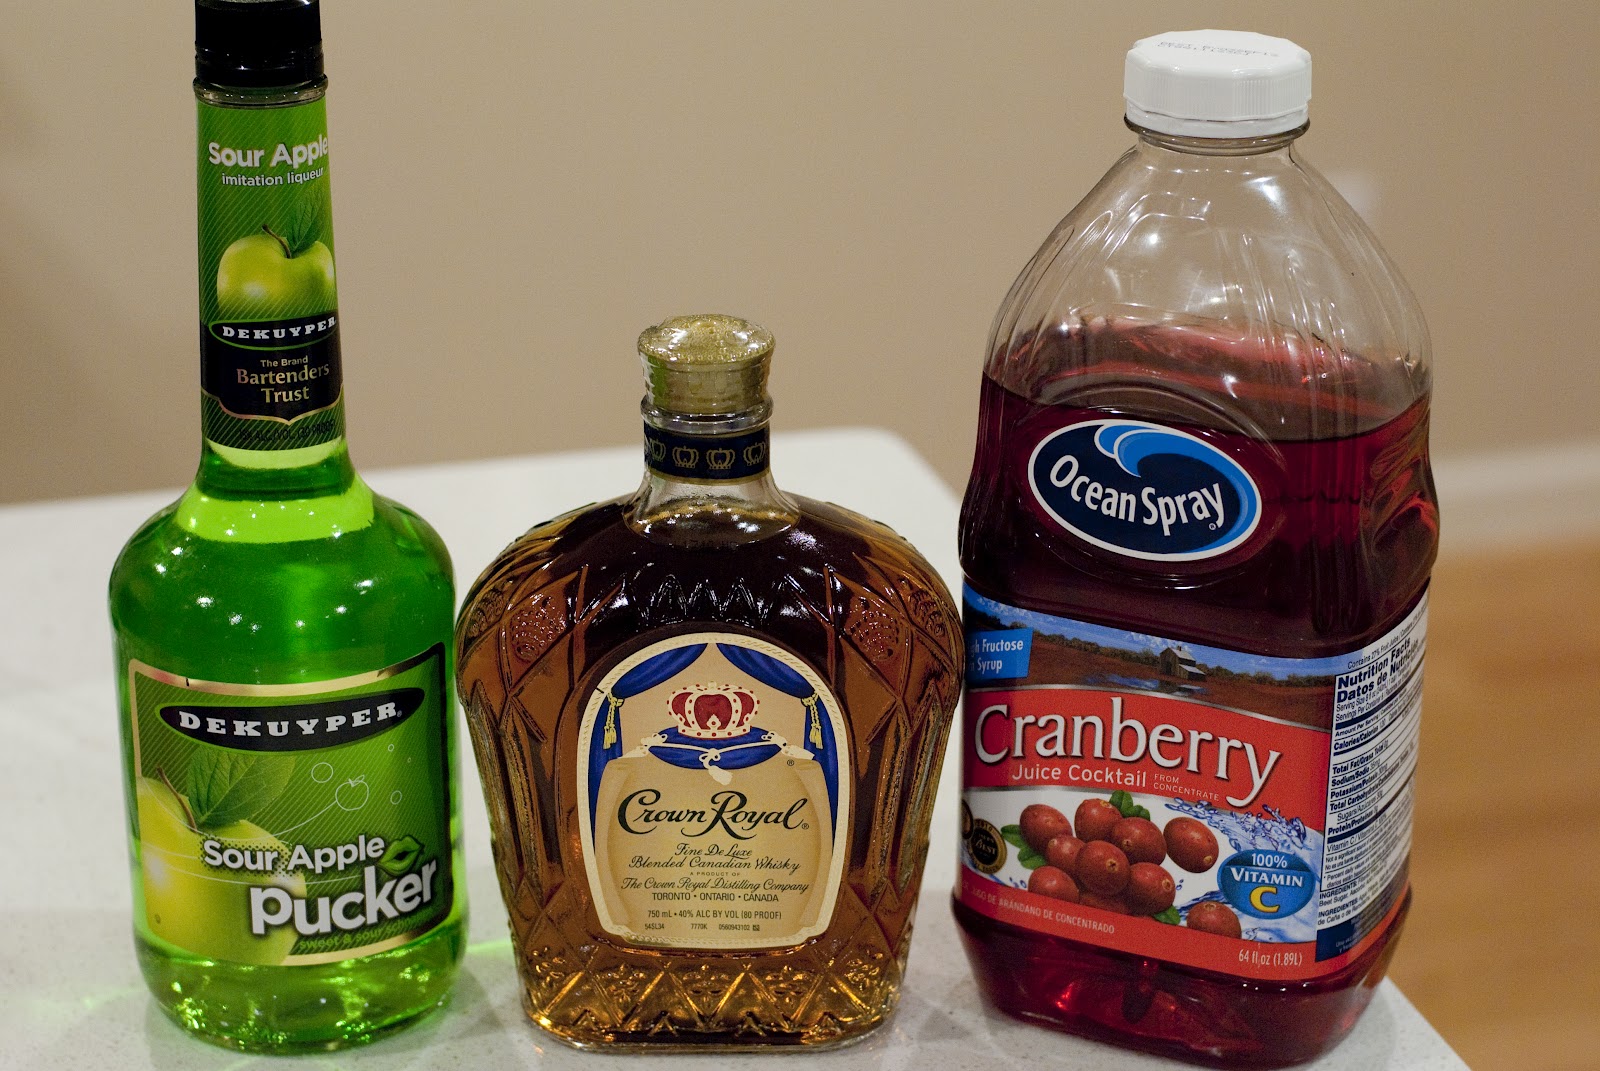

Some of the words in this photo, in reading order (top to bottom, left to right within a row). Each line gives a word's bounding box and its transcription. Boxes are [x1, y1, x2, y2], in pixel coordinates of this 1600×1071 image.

[208, 141, 265, 167] Sour
[269, 133, 328, 169] Apple
[222, 172, 283, 186] imitation
[287, 167, 324, 185] liqueur
[222, 317, 337, 339] DEKUYPER
[260, 359, 279, 368] The
[281, 355, 309, 367] Brand
[236, 363, 330, 385] Bartenders
[260, 386, 310, 403] Trust
[1050, 455, 1136, 523] Ocean
[1141, 483, 1225, 537] Spray
[982, 639, 1024, 652] Fructose
[977, 656, 1003, 674] Syrup
[1337, 657, 1389, 689] Nutrition
[1391, 637, 1411, 662] Facts
[1347, 655, 1371, 669] Contains
[1336, 681, 1375, 703] Datos
[1377, 671, 1387, 685] de
[1335, 709, 1357, 722] Servings
[1357, 706, 1365, 715] Per
[1336, 698, 1355, 713] Serving
[179, 702, 397, 737] DEKUYPER
[1335, 726, 1357, 737] Amount
[1357, 722, 1365, 731] Per
[974, 697, 1281, 807] Cranberry
[1012, 763, 1062, 781] Juice
[1069, 765, 1147, 788] Cocktail
[1332, 764, 1349, 775] Total
[1154, 773, 1179, 784] FROM
[1153, 782, 1220, 801] CONCENTRATE
[1329, 800, 1347, 811] Total
[618, 789, 707, 835] Crown
[681, 790, 808, 840] Royal
[203, 840, 280, 871] Sour
[286, 835, 385, 873] Apple
[674, 843, 703, 856] Fine
[704, 843, 725, 856] De
[724, 843, 753, 860] Luxe
[1326, 839, 1349, 853] Vitamin
[628, 856, 685, 869] Blended
[689, 857, 751, 869] Canadian
[754, 856, 801, 876] Whisky
[1251, 853, 1288, 869] 100%
[621, 878, 642, 889] The
[643, 878, 676, 890] Crown
[677, 877, 710, 892] Royal
[711, 878, 761, 892] Distilling
[763, 879, 809, 892] Company
[1230, 867, 1303, 887] VITAMIN
[249, 860, 437, 936] pucker
[652, 893, 691, 901] TORONTO
[700, 893, 735, 901] ONTARIO
[743, 893, 779, 902] CANADA
[1250, 885, 1280, 913] C
[1319, 899, 1333, 907] Beet
[647, 910, 660, 918] 750
[662, 910, 672, 918] mL
[679, 910, 693, 918] 40%
[696, 910, 710, 918] ALC
[713, 910, 722, 918] BY
[725, 910, 739, 919] VOL
[741, 910, 752, 919] (80
[754, 911, 782, 920] PROOF)
[1043, 909, 1053, 920] DE
[1056, 913, 1115, 934] CONCENTRADO
[1317, 918, 1325, 926] de
[1238, 949, 1249, 963] 64
[1251, 951, 1258, 964] fl
[1260, 954, 1270, 965] oz
[1273, 952, 1303, 966] (1.89L)
